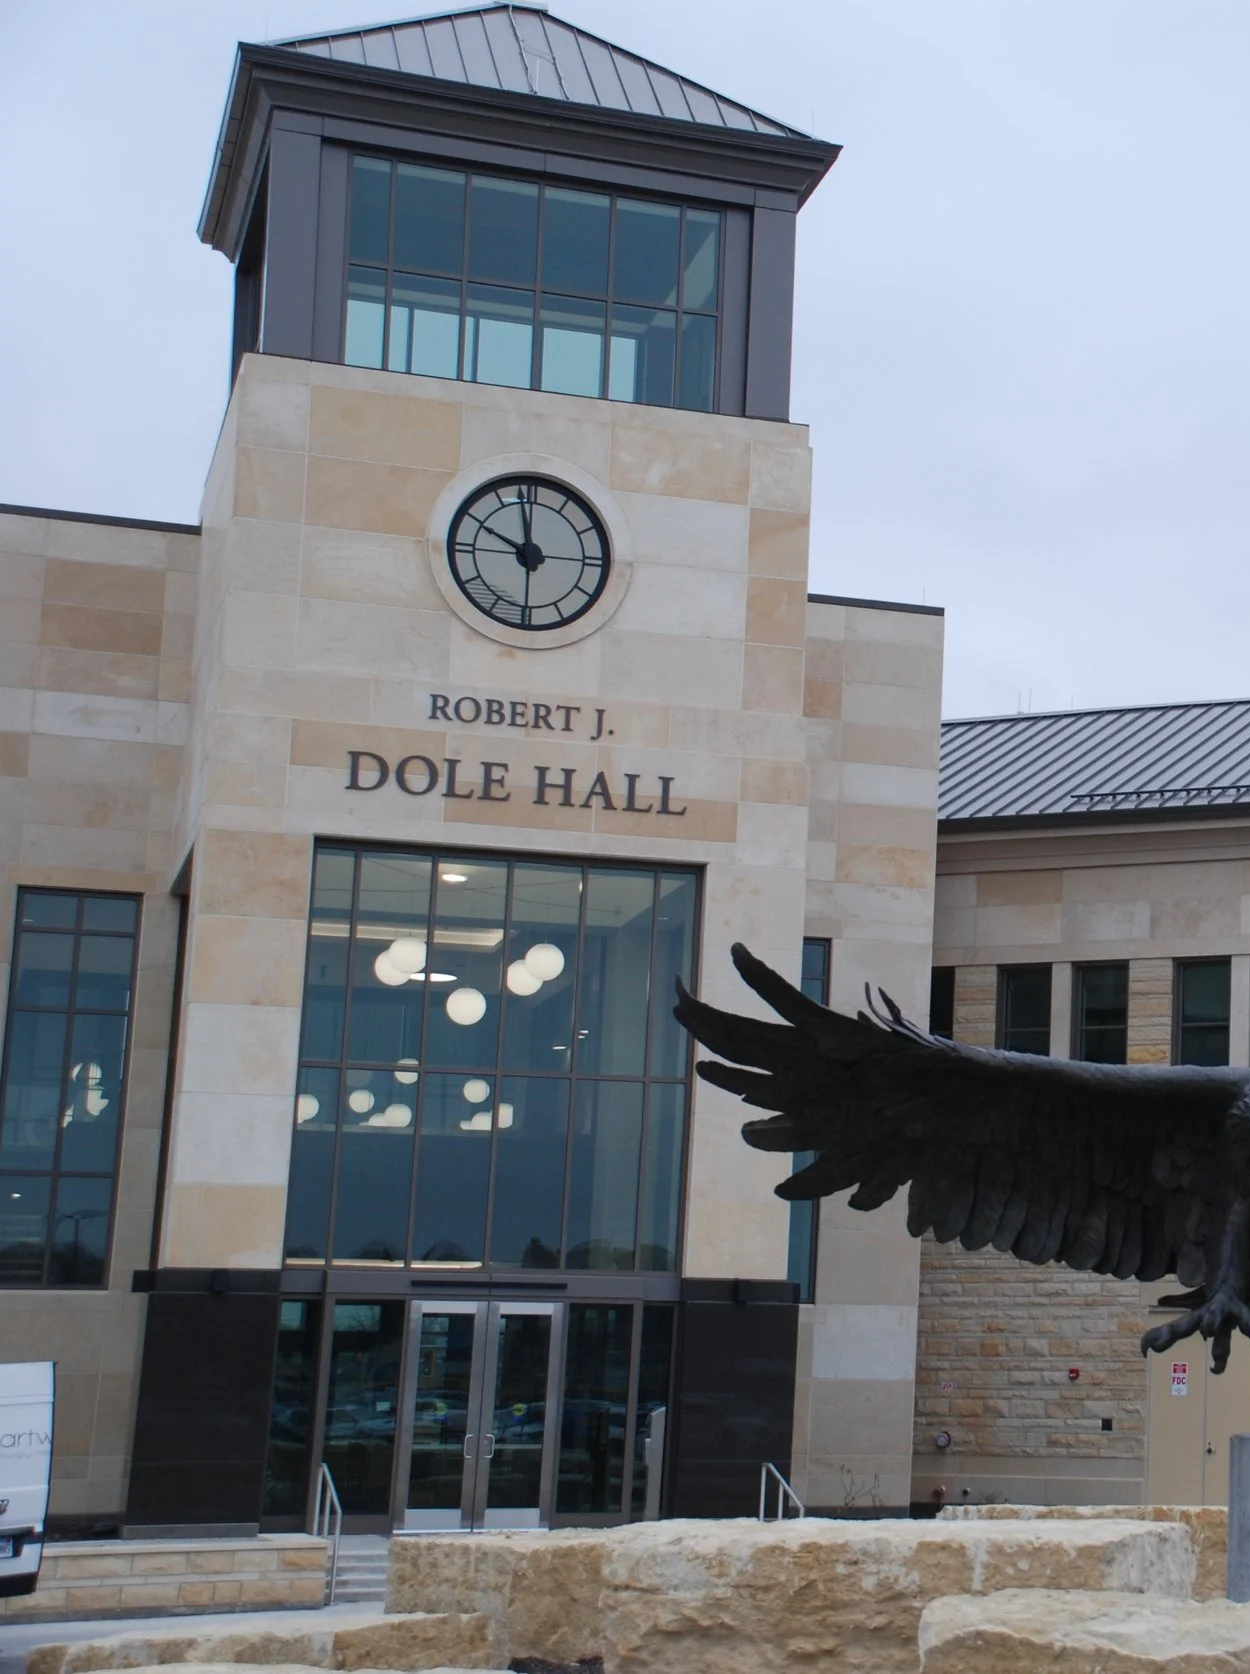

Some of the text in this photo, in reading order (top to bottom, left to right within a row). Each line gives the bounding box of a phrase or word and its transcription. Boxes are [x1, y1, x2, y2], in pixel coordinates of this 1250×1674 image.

[428, 693, 615, 740] ROBERT J.
[345, 750, 687, 816] DOLE HALL
[1172, 1376, 1186, 1385] FDC
